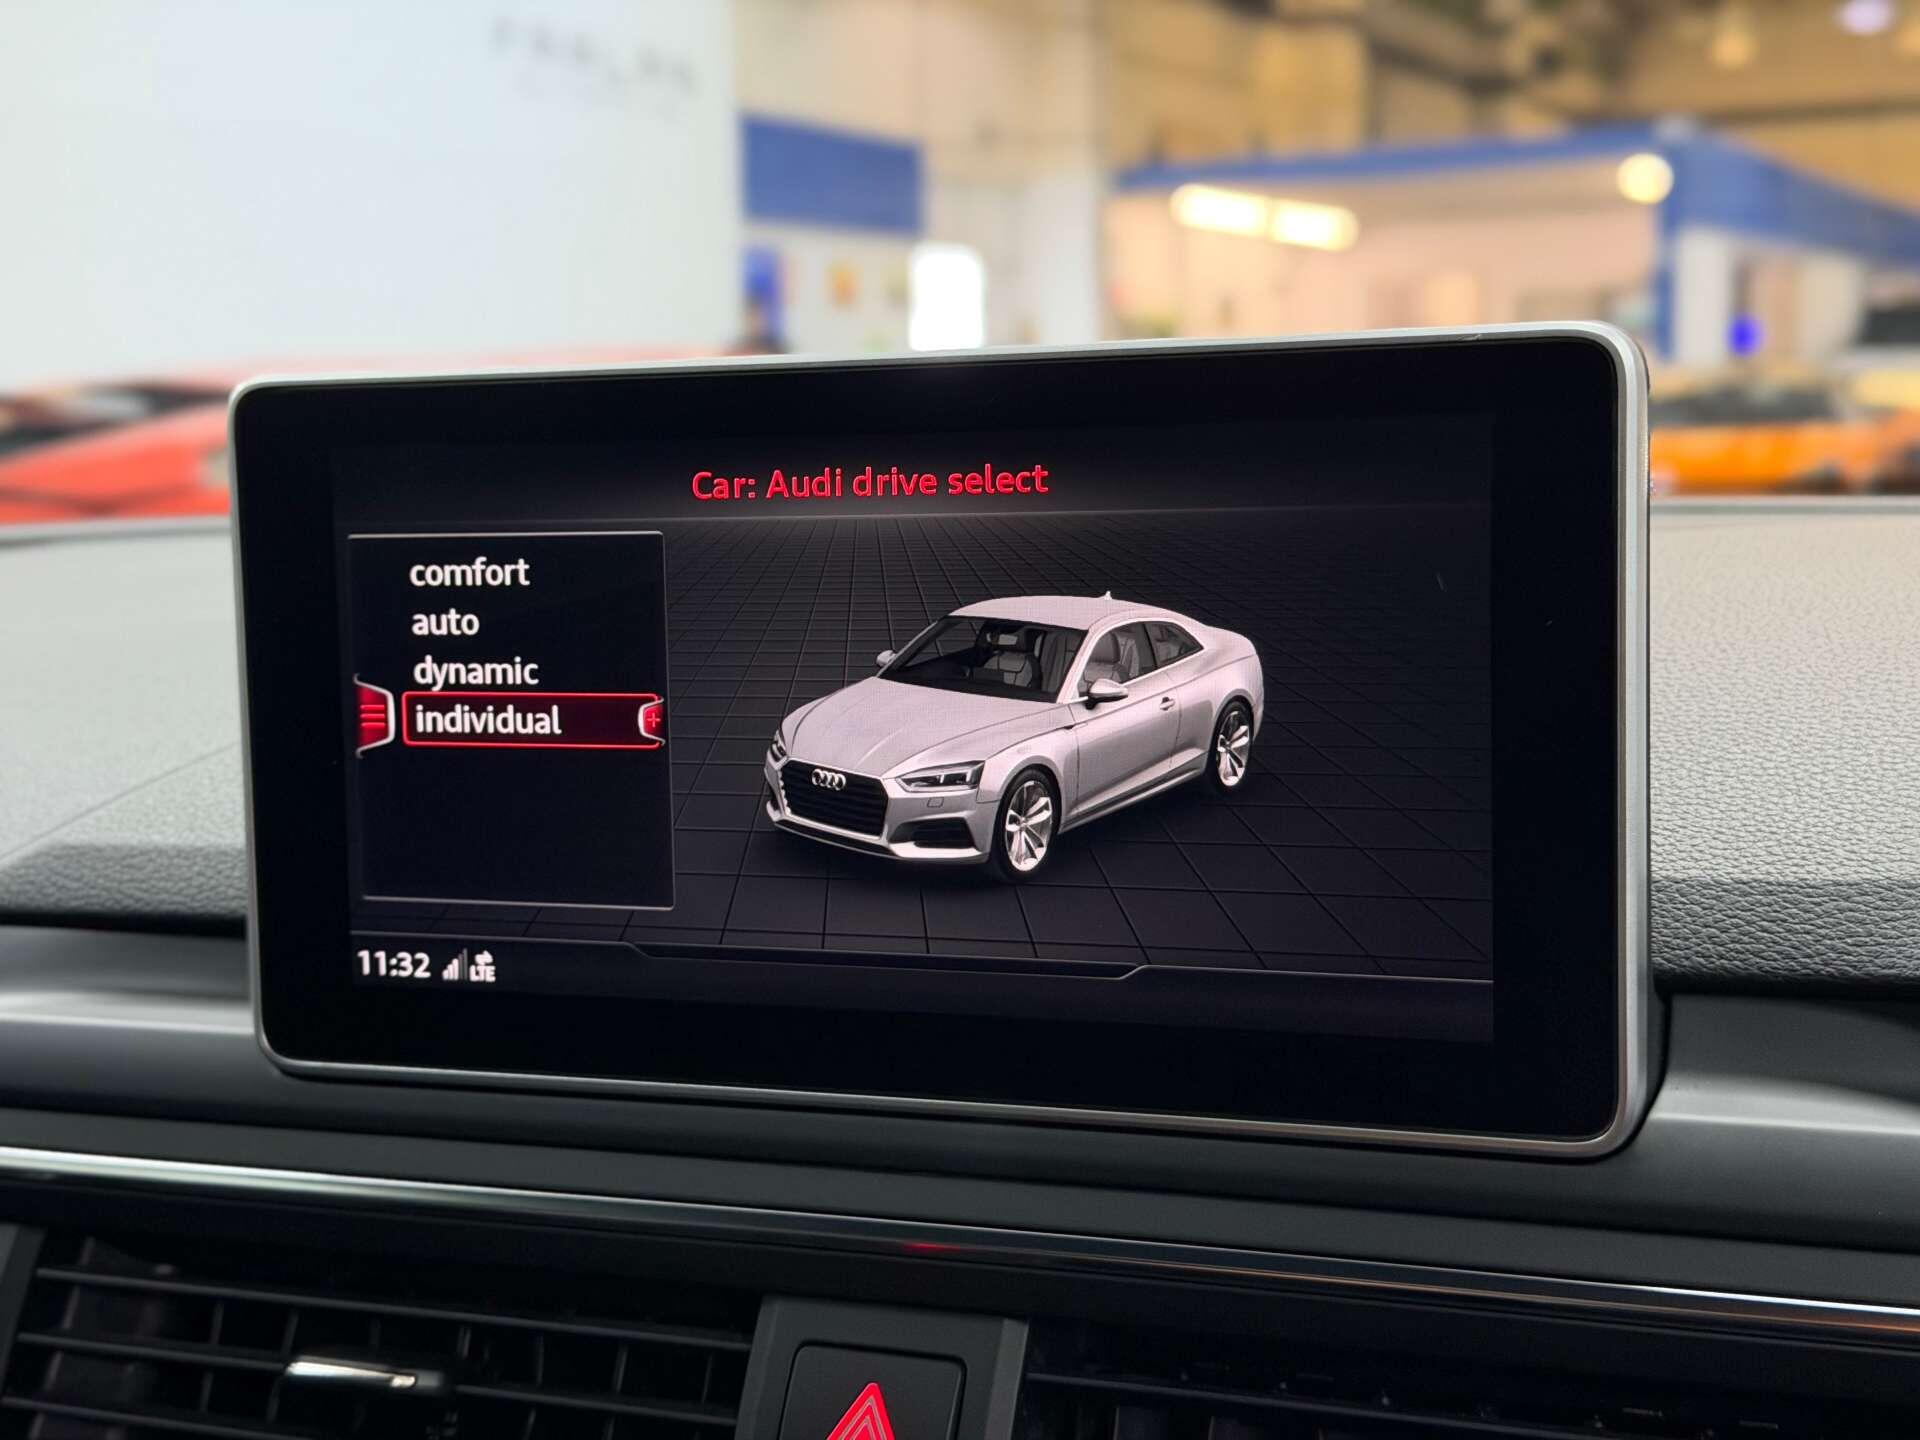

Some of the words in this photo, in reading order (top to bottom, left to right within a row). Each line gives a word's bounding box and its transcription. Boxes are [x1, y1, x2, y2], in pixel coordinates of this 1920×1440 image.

[692, 472, 756, 500] Car:
[766, 467, 843, 499] Audi
[853, 467, 938, 497] drive
[948, 464, 1049, 496] select
[410, 556, 530, 587] comfort
[411, 608, 480, 636] auto
[413, 654, 539, 691] dynamic
[415, 703, 562, 735] individual
[357, 949, 432, 978] 11:32
[469, 965, 496, 982] LTE
